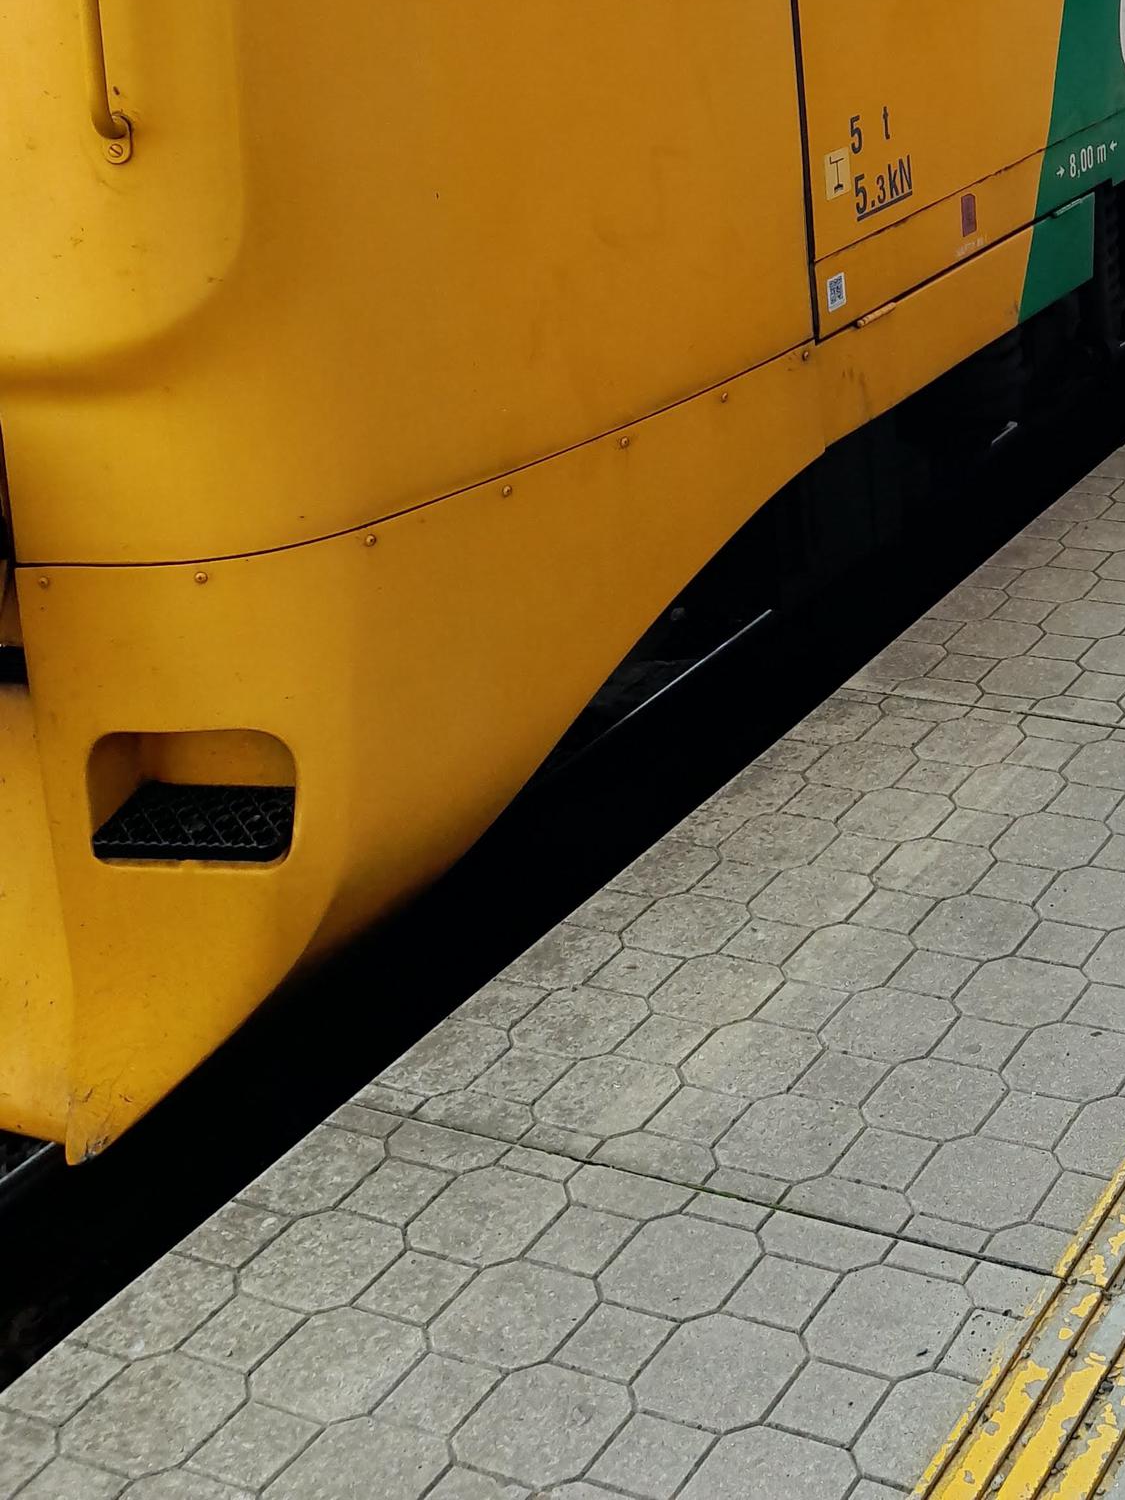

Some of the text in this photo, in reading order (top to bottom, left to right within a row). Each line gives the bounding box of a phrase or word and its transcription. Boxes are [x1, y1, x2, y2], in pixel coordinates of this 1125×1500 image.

[850, 106, 891, 154] 5 t
[1069, 143, 1107, 179] 8,00 m
